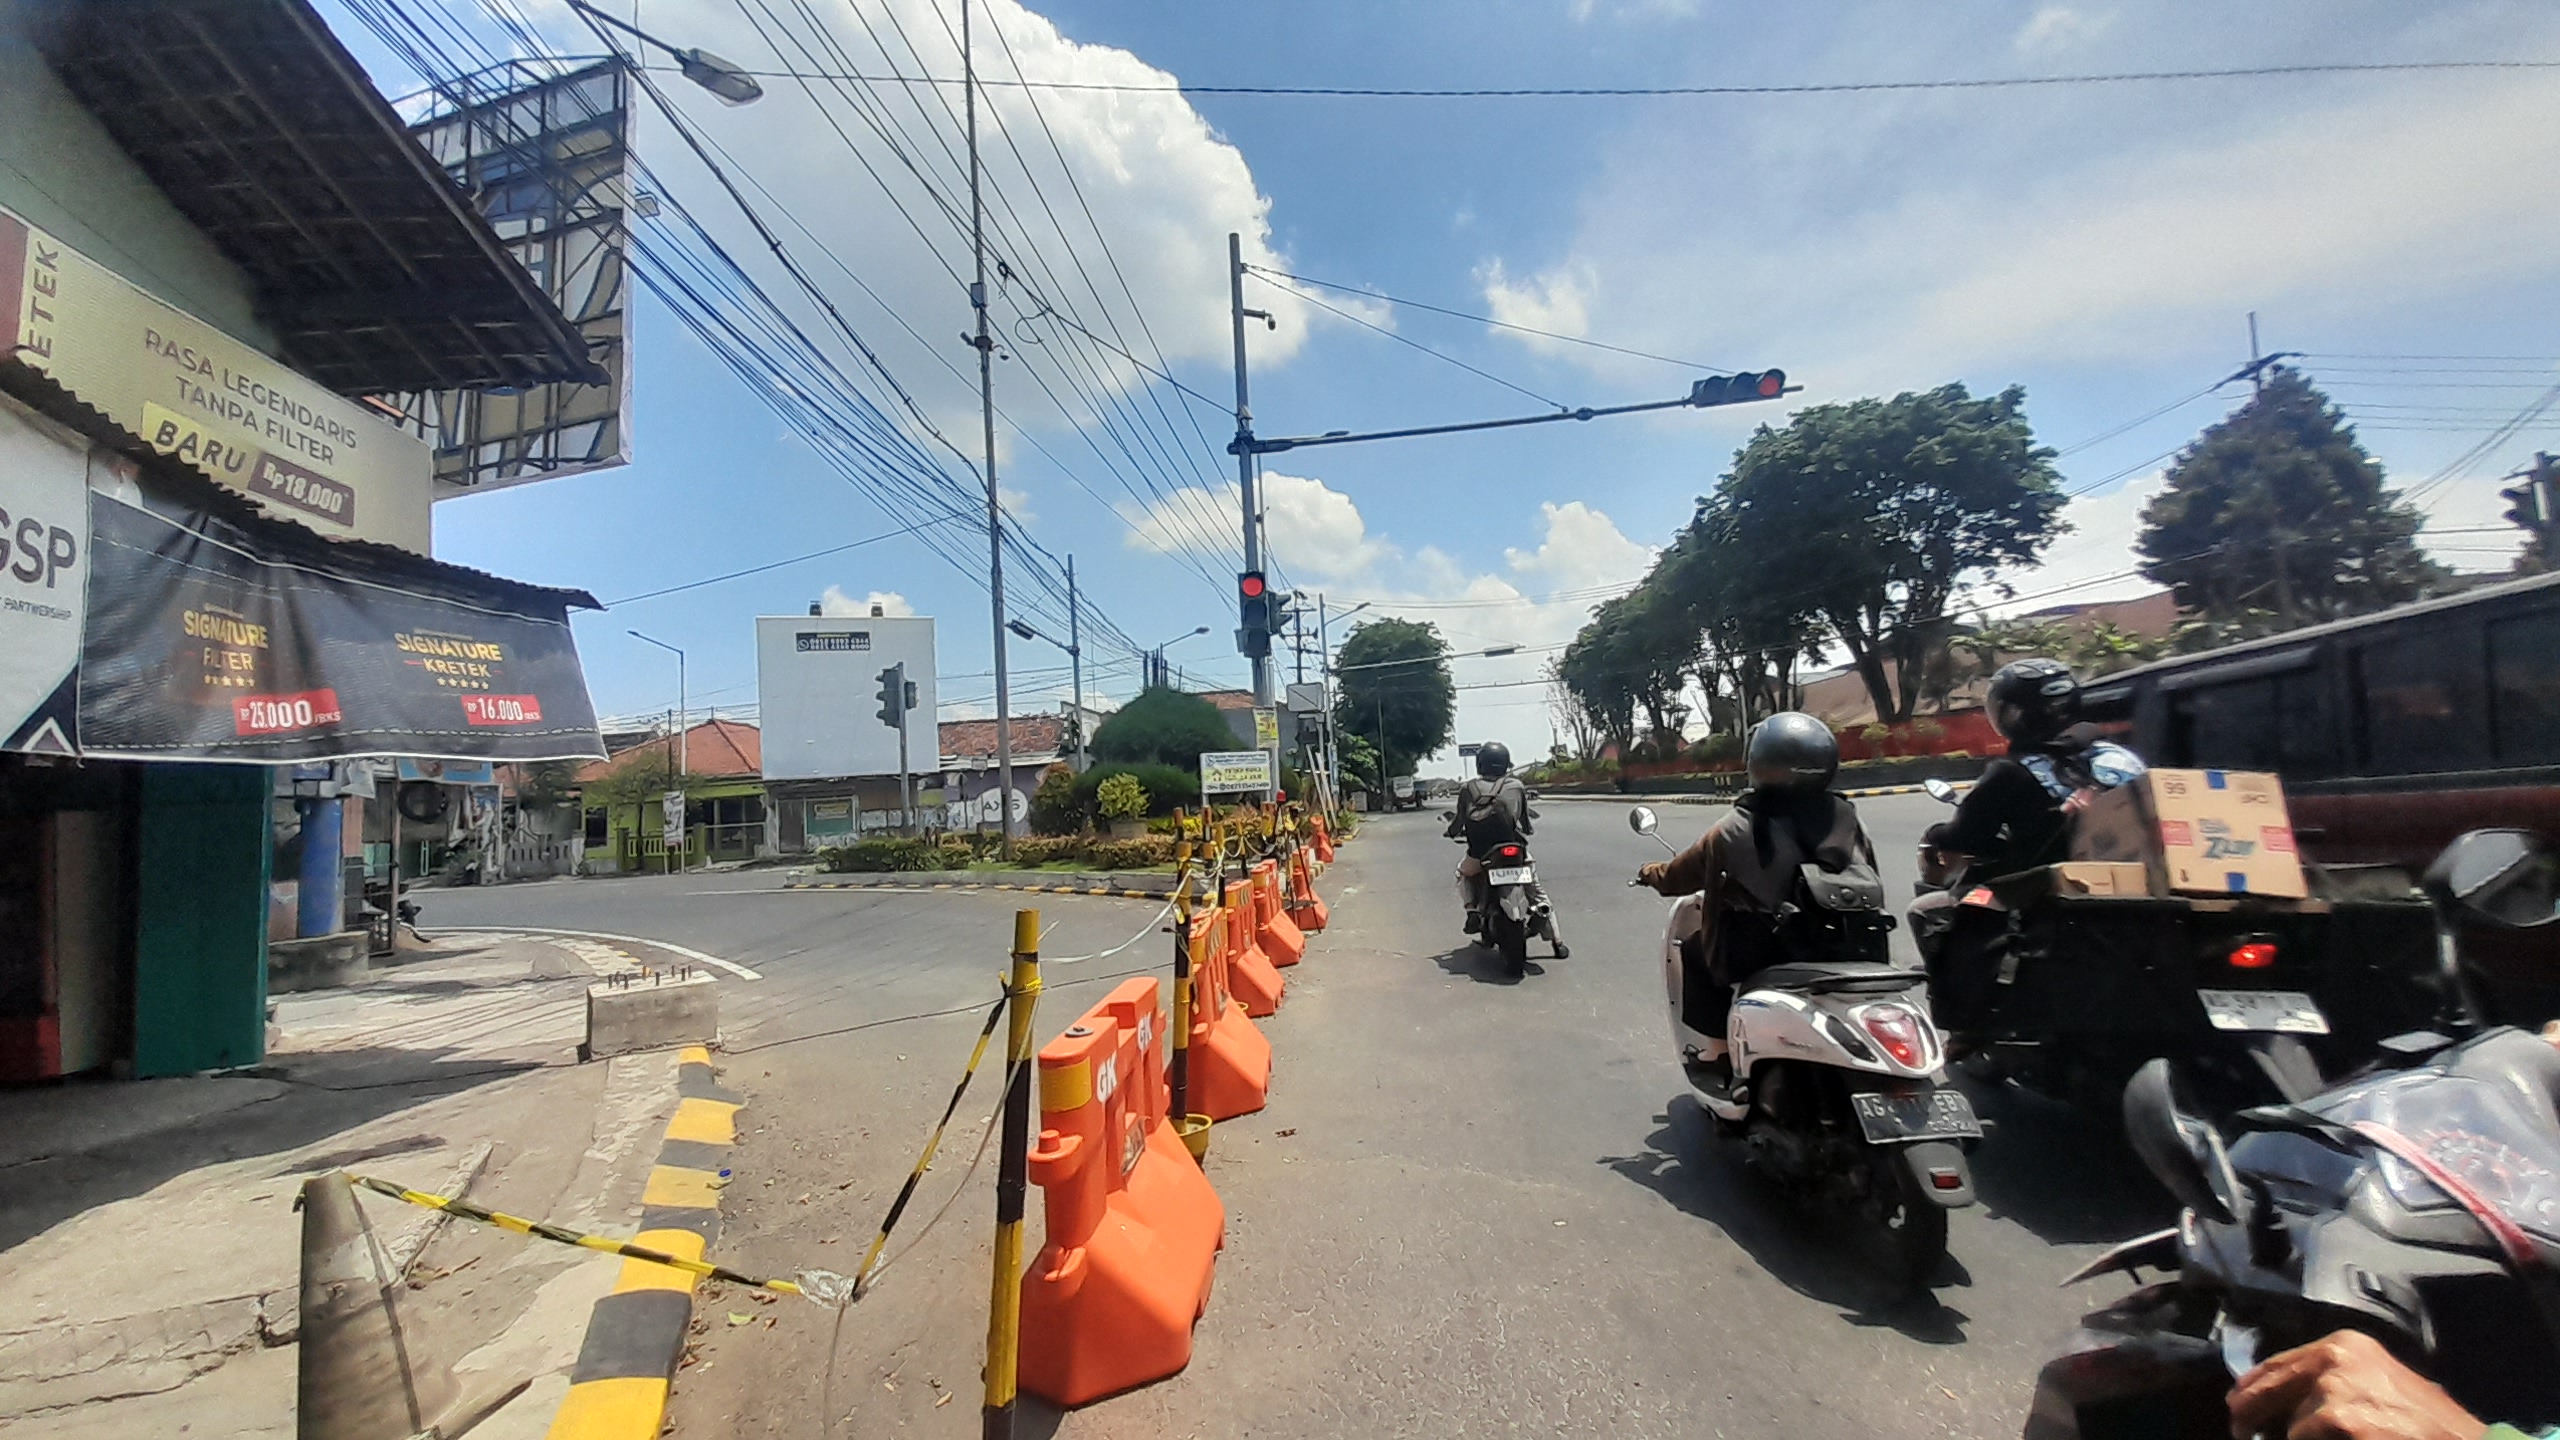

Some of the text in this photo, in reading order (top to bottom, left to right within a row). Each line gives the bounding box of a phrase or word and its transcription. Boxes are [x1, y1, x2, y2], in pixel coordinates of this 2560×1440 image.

[29, 240, 59, 376] ETEK
[145, 327, 357, 449] RASA LEGENDARIS
[176, 375, 334, 465] TANPA FILTER
[155, 420, 247, 473] BARU
[183, 610, 269, 649] SIGNATURE
[394, 633, 503, 661] SIGNATURE
[203, 646, 254, 671] FILTER
[423, 657, 492, 678] KRETEK
[477, 697, 524, 721] 16.000
[1097, 1051, 1118, 1103] GK
